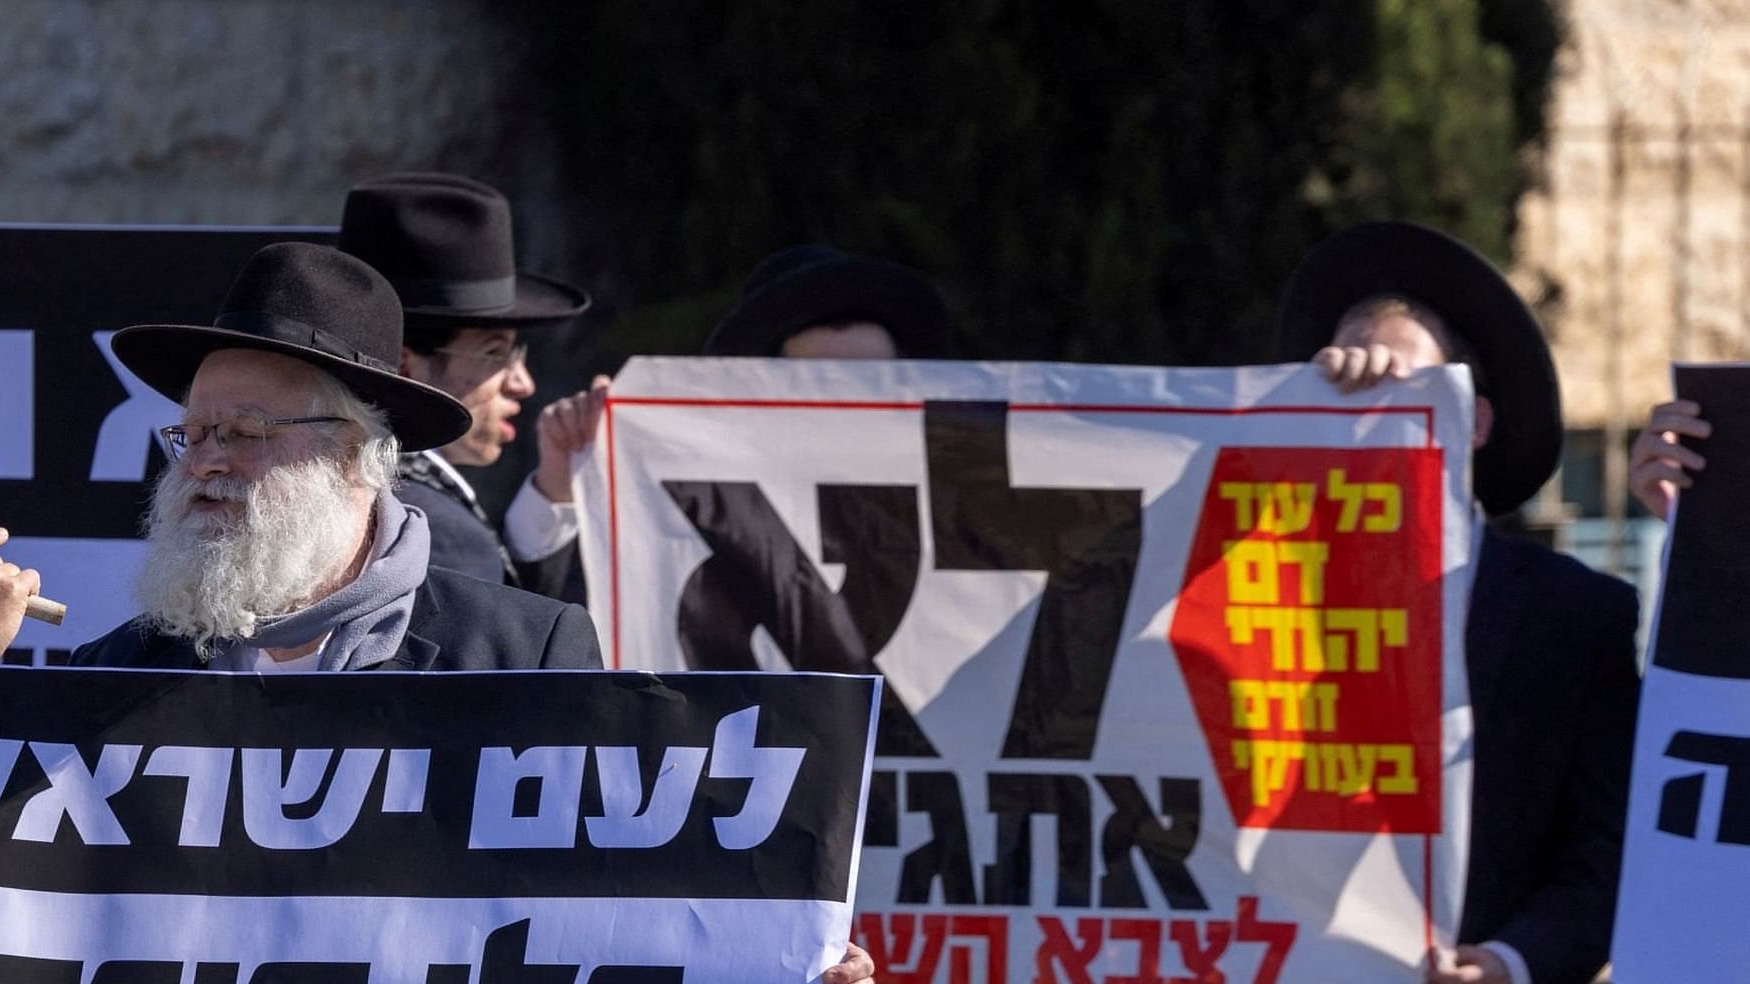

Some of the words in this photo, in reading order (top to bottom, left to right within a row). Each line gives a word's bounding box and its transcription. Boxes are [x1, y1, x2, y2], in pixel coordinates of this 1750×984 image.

[1219, 482, 1315, 536] עוד
[1327, 469, 1402, 533] כל
[663, 400, 1143, 760] לא
[1222, 541, 1329, 605] דם
[1225, 606, 1408, 672] יהודי
[1229, 680, 1339, 732] זורם
[468, 706, 806, 850] לעם
[1232, 740, 1417, 807] בעורקי
[864, 771, 1211, 911] אתגי
